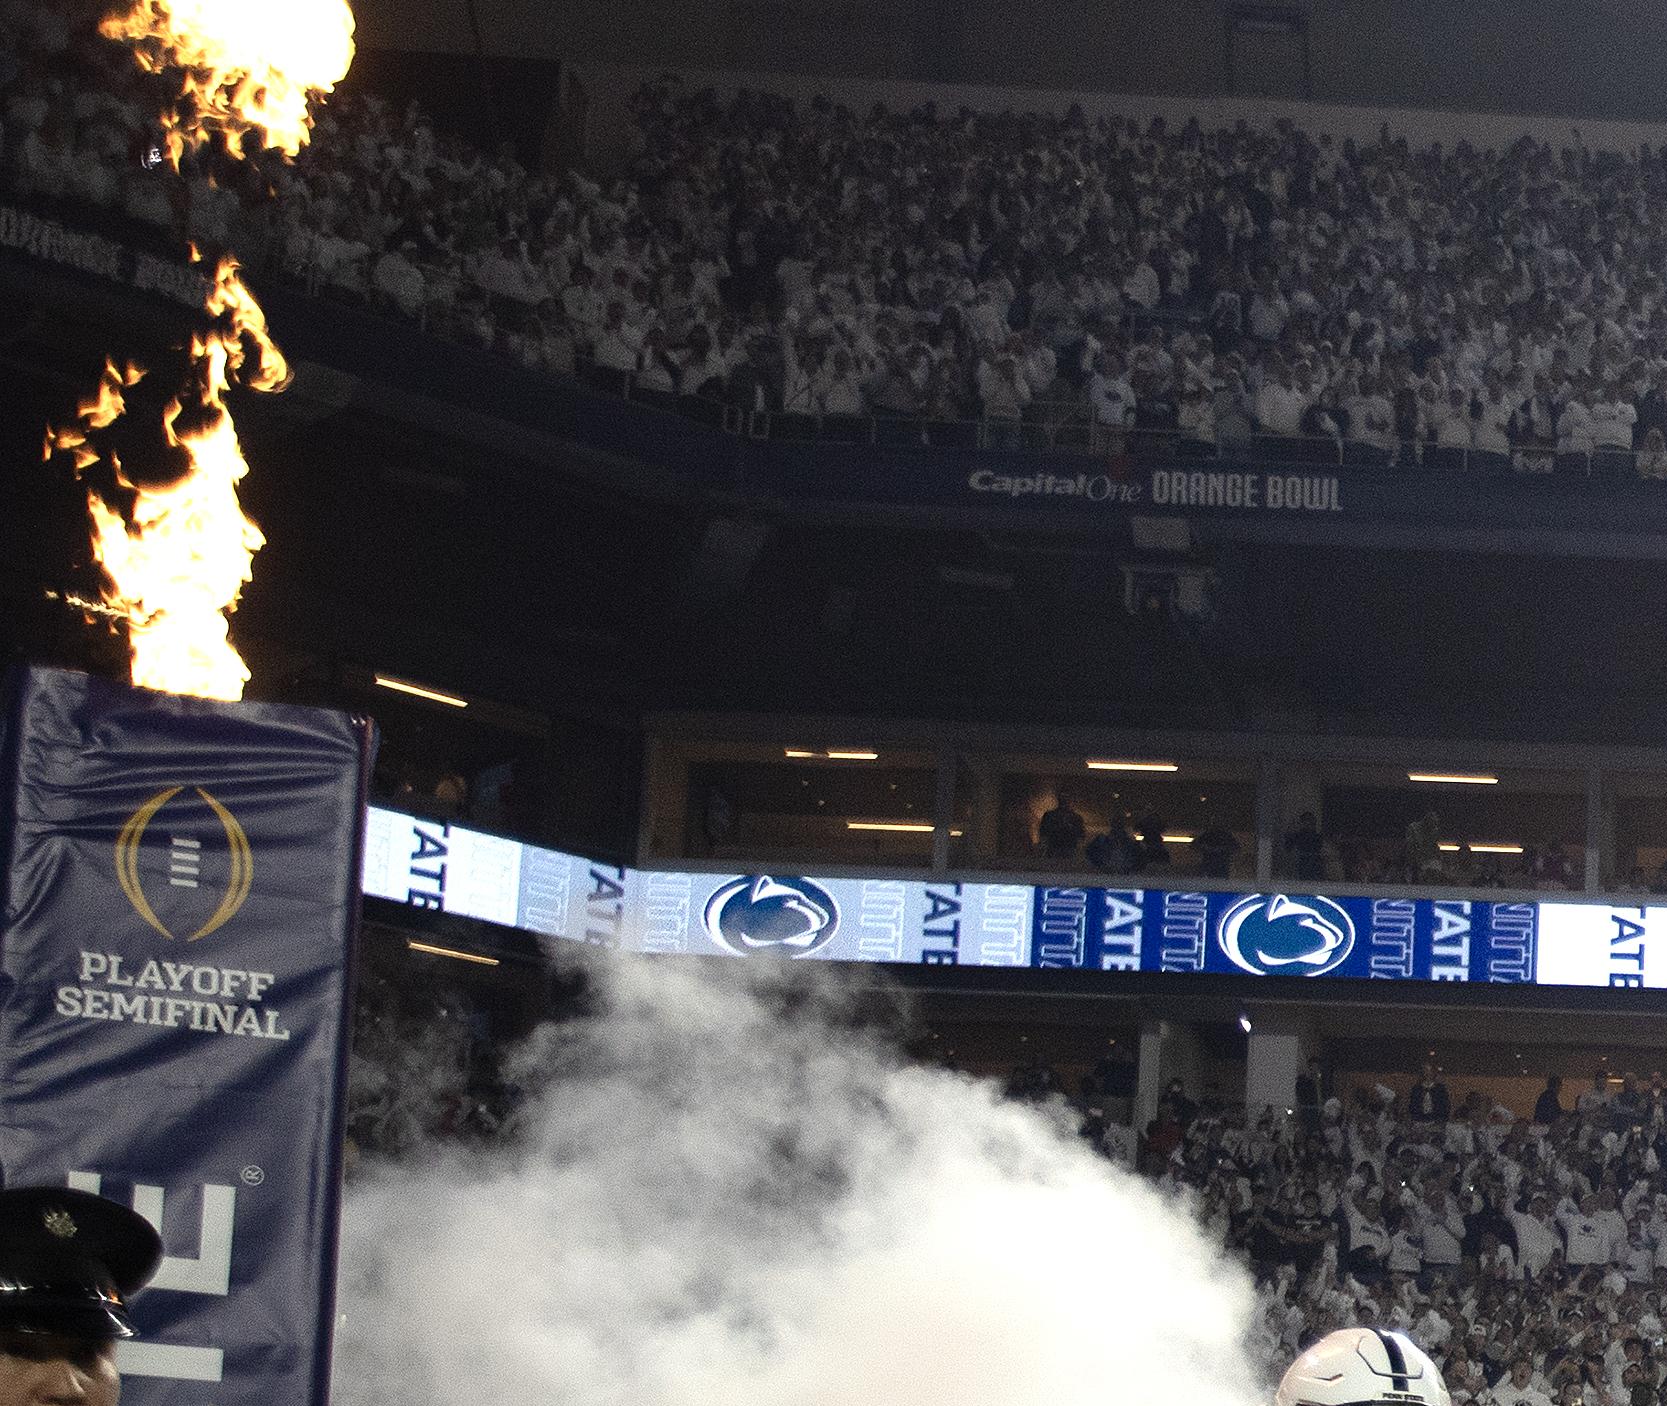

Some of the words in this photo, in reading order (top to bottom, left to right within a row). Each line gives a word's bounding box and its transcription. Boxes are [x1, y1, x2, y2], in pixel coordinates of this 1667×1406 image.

[1152, 472, 1259, 509] ORANGE
[1266, 475, 1342, 512] BOWL
[79, 951, 275, 1003] PLAYOFF
[55, 986, 291, 1042] SEMIFINAL
